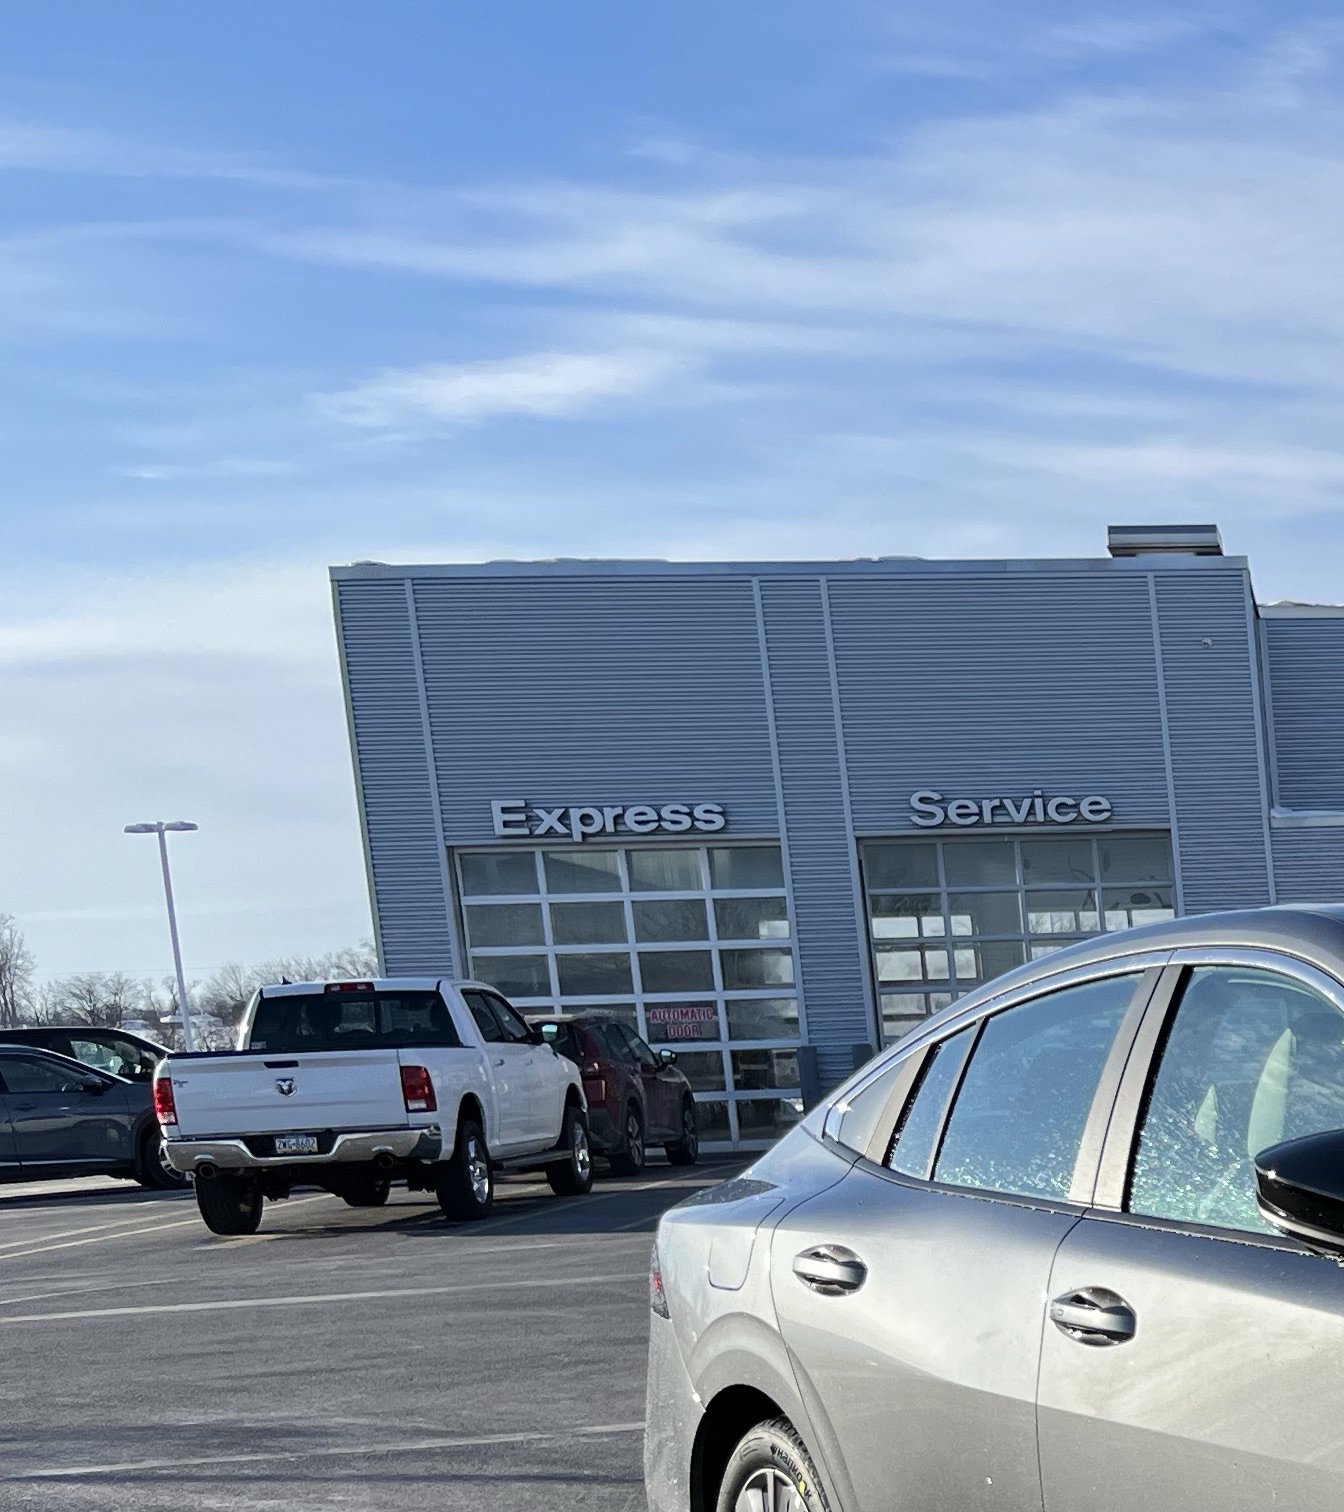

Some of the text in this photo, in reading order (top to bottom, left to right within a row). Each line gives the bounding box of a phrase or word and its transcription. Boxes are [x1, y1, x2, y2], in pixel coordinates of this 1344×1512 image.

[490, 799, 727, 843] Express
[909, 790, 1113, 827] Service
[650, 1007, 714, 1024] AUTOMATIC
[667, 1024, 701, 1039] DOOR
